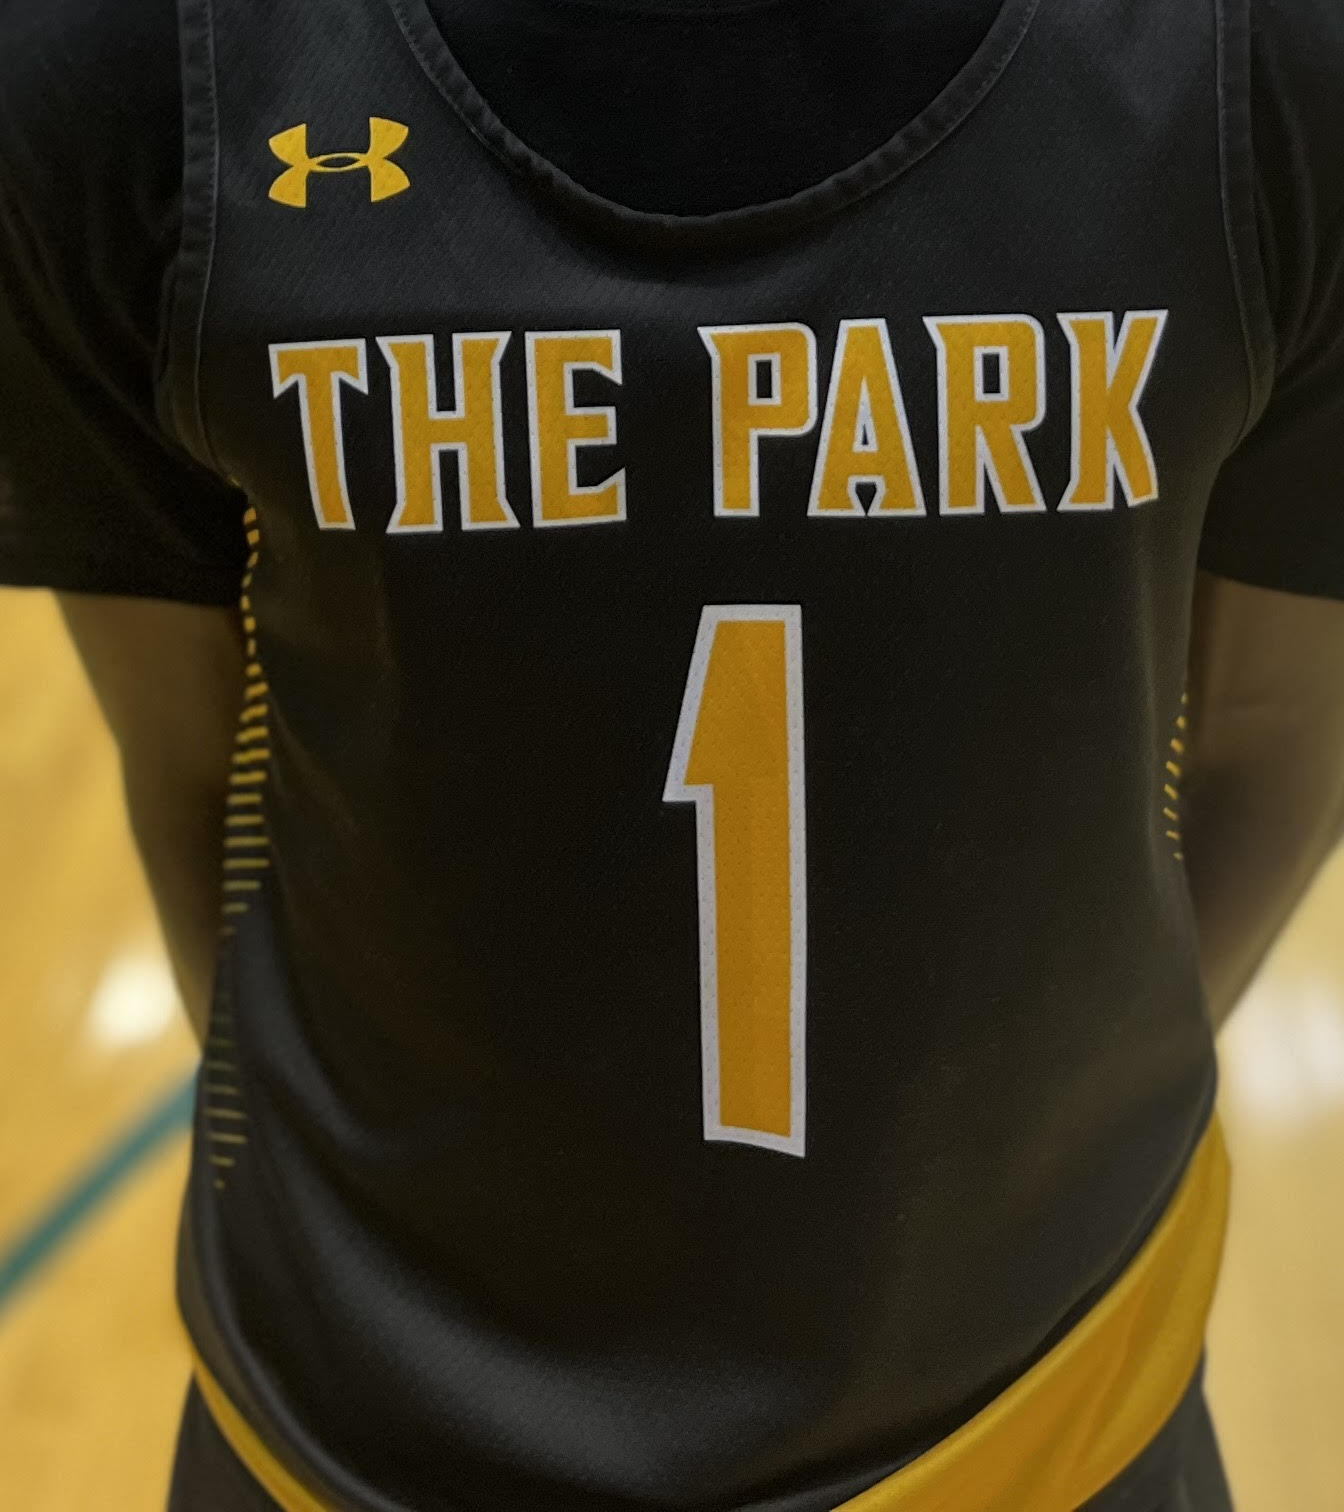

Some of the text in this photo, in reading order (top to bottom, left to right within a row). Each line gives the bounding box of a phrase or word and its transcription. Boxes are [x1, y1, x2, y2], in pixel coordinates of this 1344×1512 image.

[268, 309, 1169, 534] THE PARK
[662, 603, 805, 1158] 1
